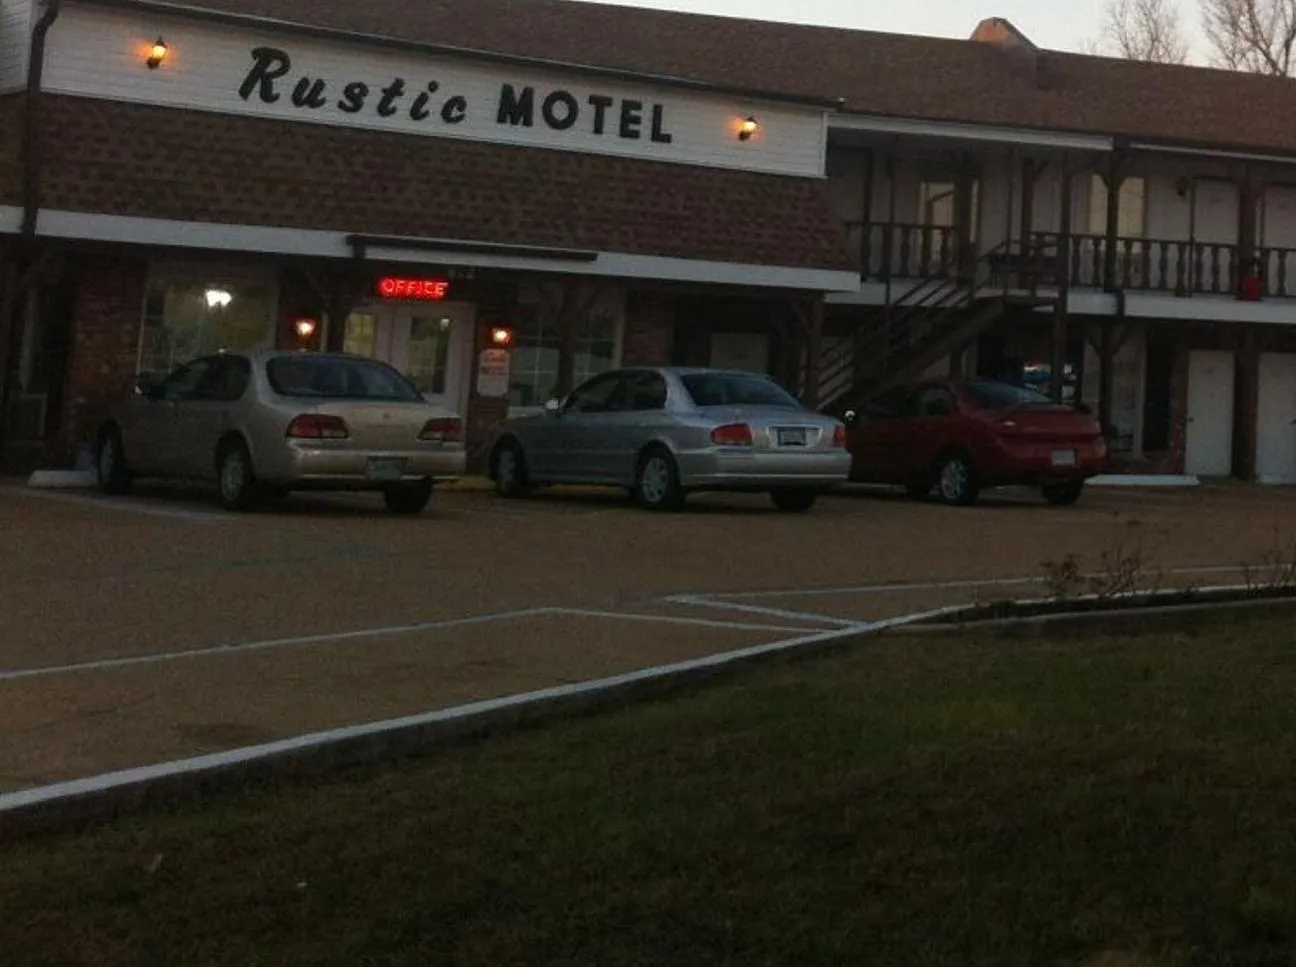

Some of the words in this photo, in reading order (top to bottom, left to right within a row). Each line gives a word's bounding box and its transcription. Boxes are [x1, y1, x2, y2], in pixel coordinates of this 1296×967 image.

[239, 46, 467, 124] Rustic
[496, 83, 672, 143] MOTEL
[380, 278, 449, 298] OFFICE
